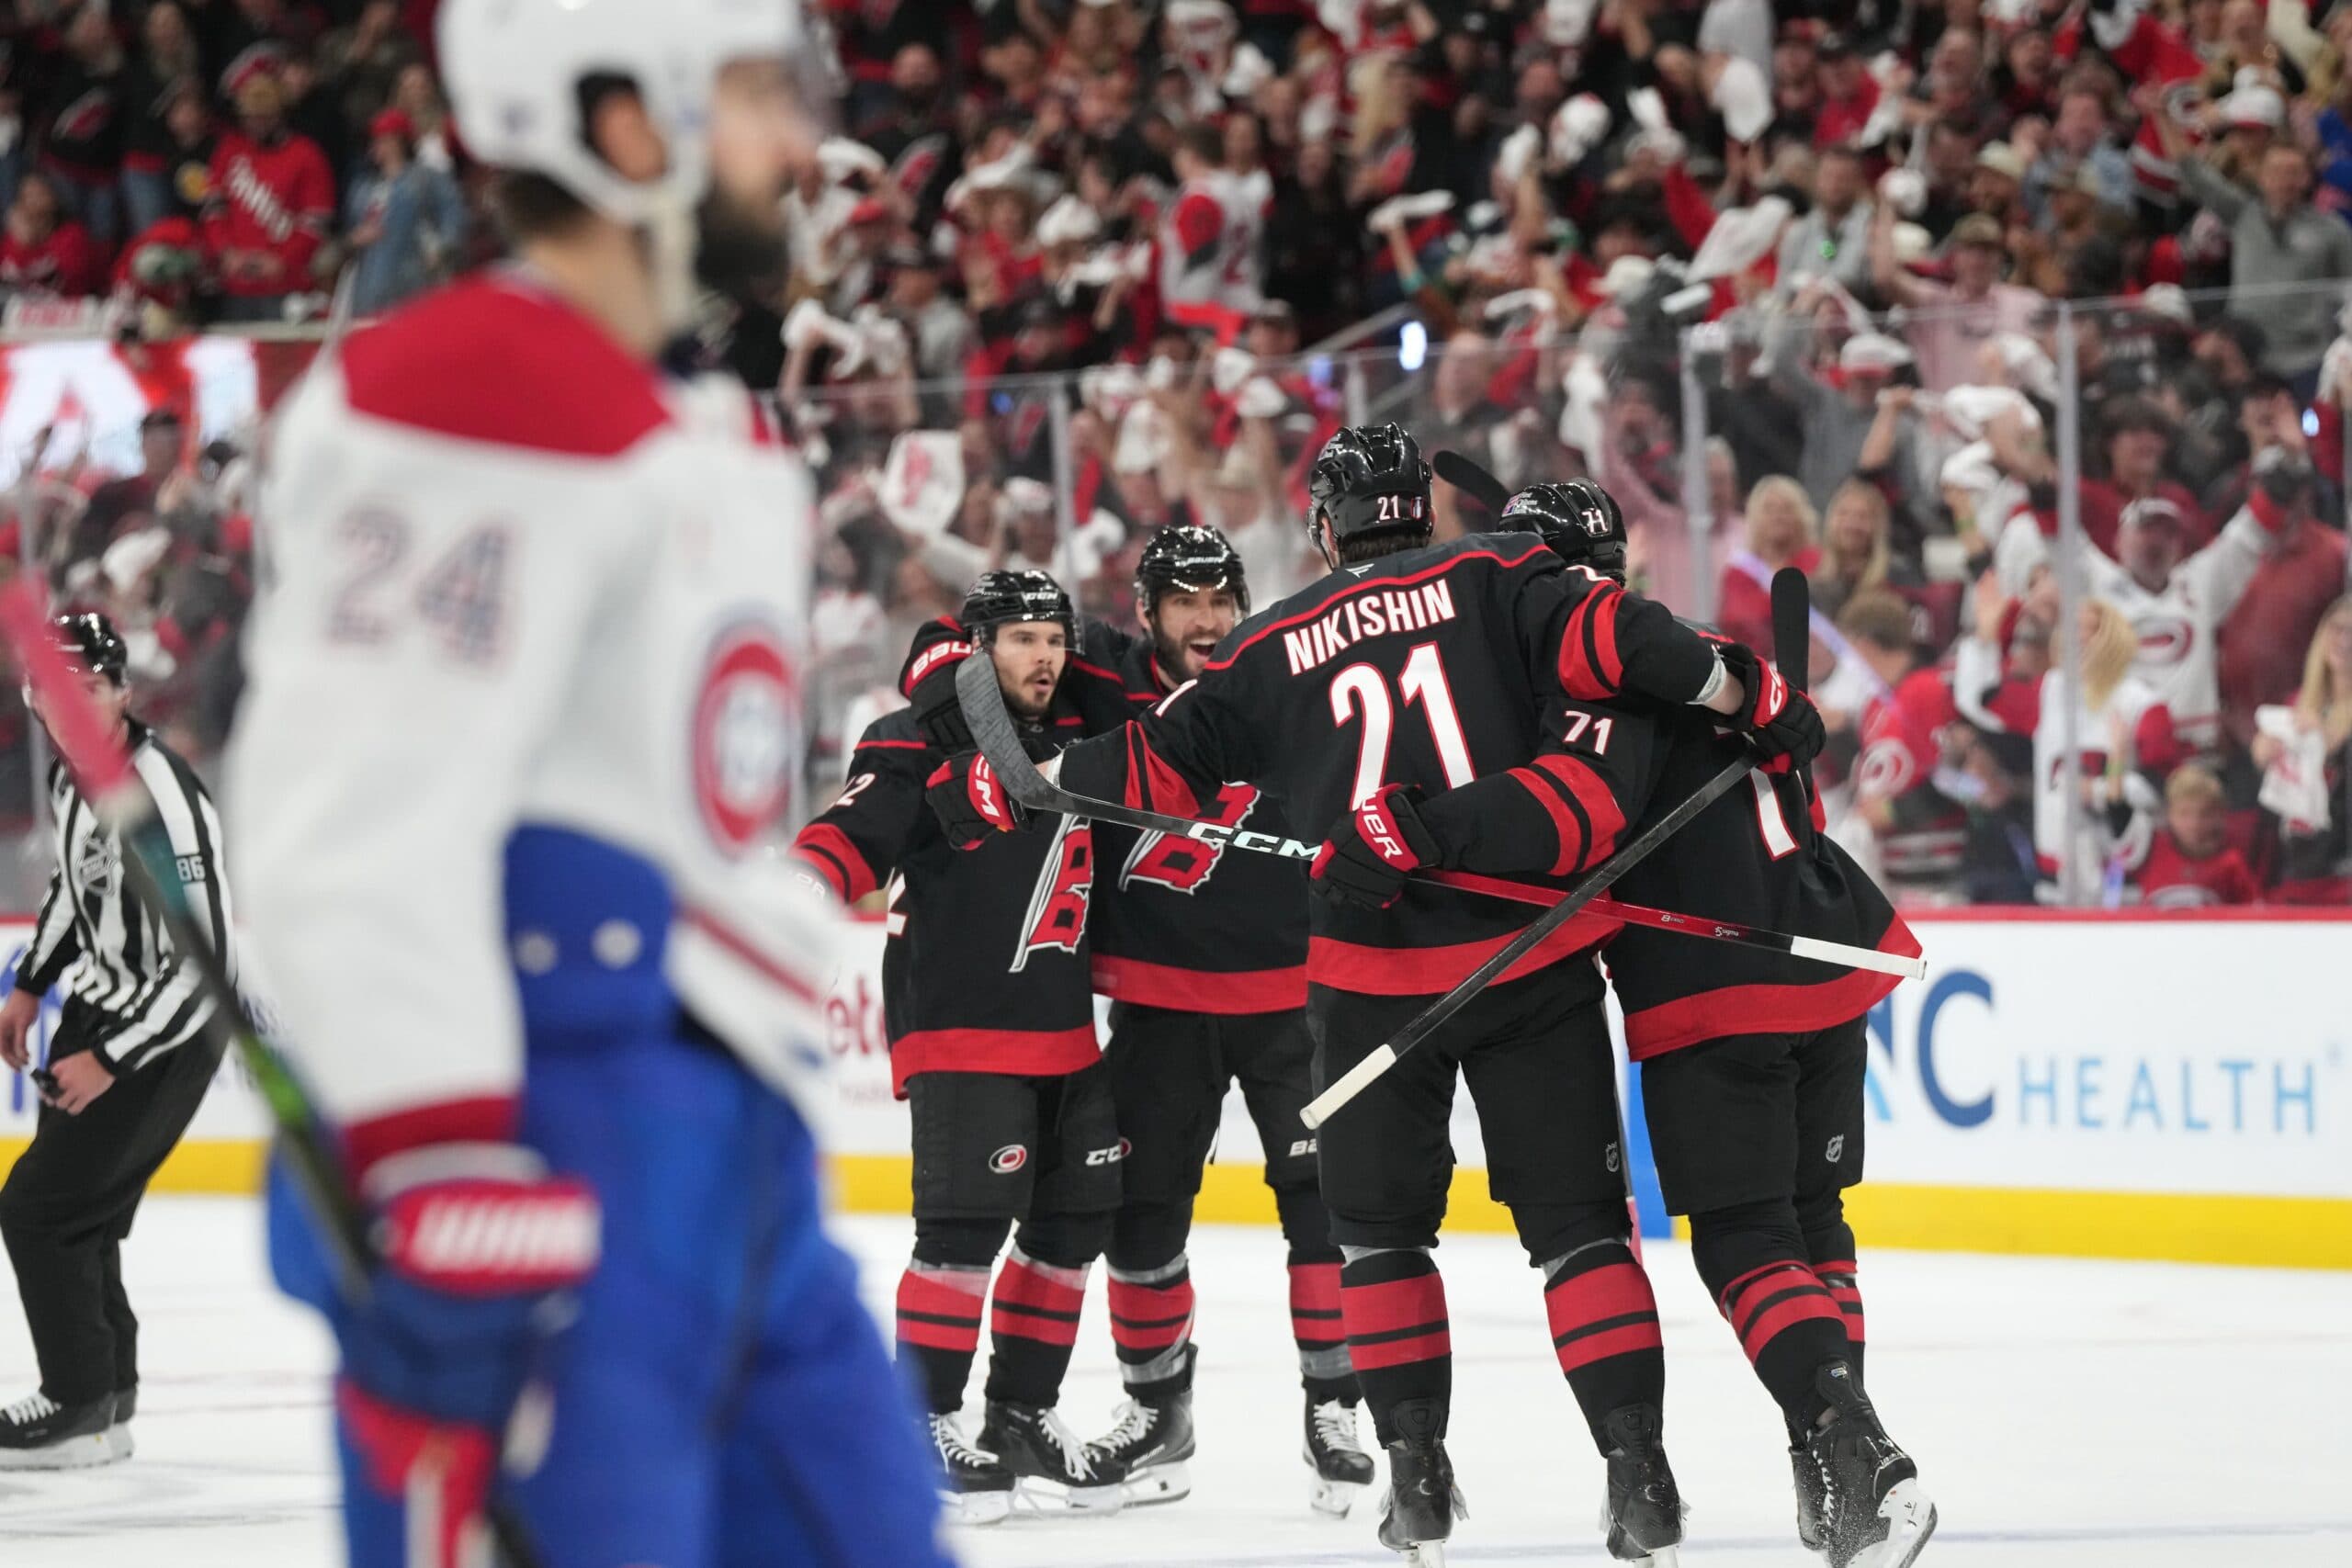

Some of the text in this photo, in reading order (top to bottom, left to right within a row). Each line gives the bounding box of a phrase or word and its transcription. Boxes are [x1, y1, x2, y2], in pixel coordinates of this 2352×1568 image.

[1377, 494, 1400, 521] 21
[322, 503, 516, 671] 24
[1283, 577, 1456, 676] NIKISHIN
[1329, 640, 1478, 811] 21
[1563, 710, 1614, 756] 71
[829, 773, 876, 809] 2
[975, 754, 1000, 817] CM
[175, 855, 206, 882] 86
[1187, 821, 1323, 862] CCM
[2018, 1055, 2316, 1134] HEALTH
